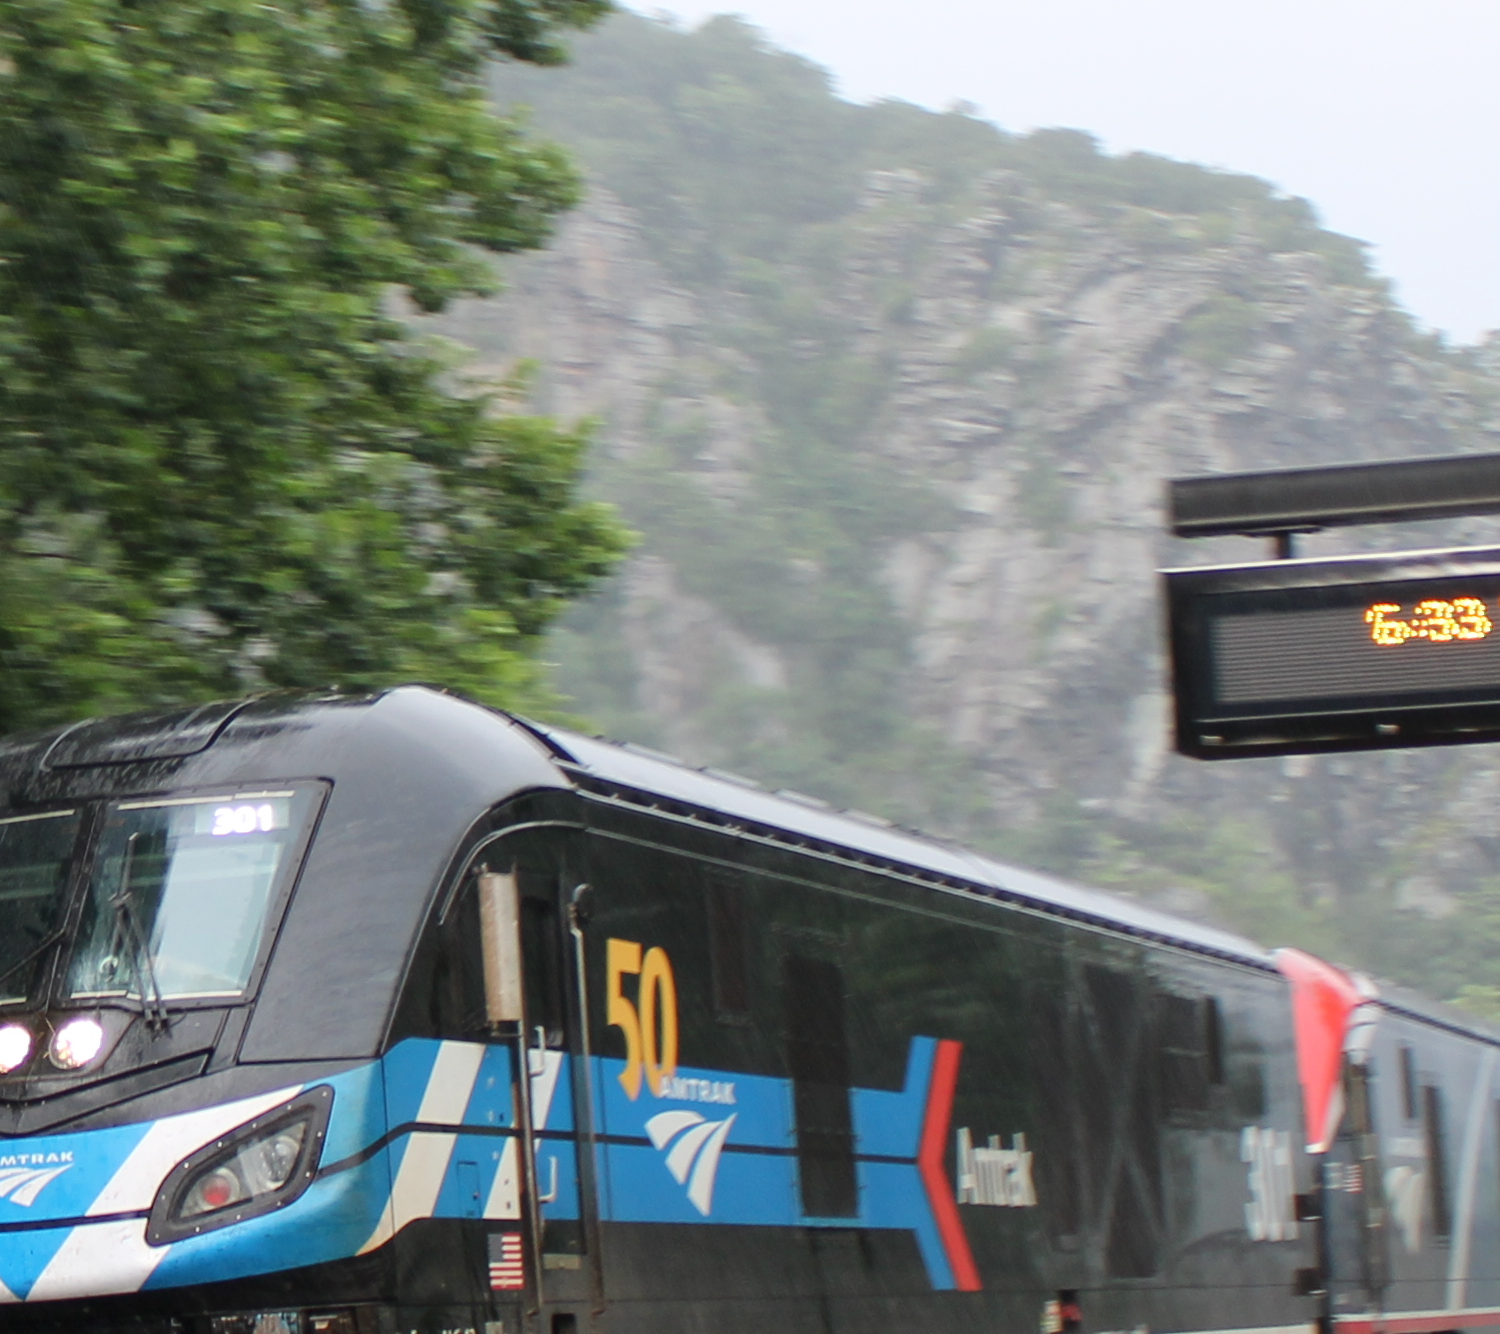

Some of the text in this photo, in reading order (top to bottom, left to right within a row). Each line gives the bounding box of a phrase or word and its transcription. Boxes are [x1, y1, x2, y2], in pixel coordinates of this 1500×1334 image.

[1365, 597, 1493, 644] 6:33
[212, 805, 273, 836] 301
[606, 937, 678, 1101] 50
[658, 1075, 737, 1104] AMTRAK
